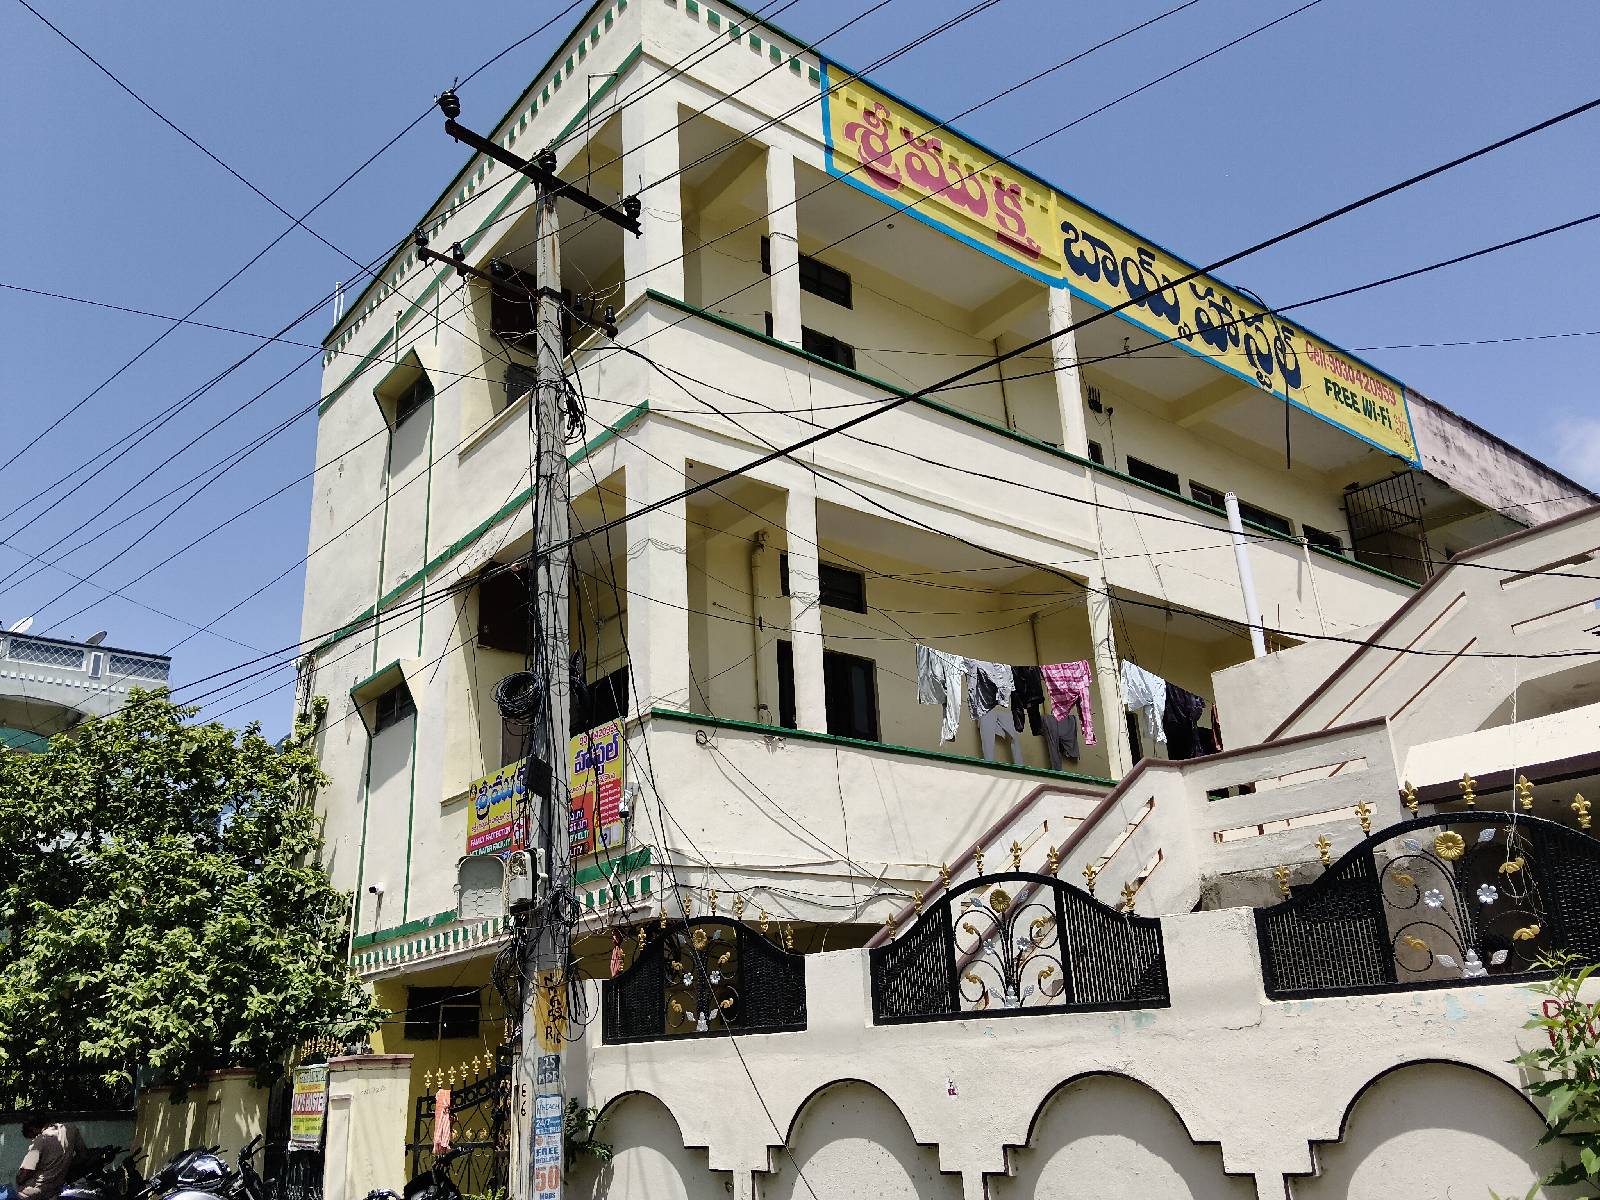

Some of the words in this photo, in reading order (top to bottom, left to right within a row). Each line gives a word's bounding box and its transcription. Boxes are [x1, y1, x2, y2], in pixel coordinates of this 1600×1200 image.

[1323, 376, 1362, 414] FREE
[535, 1146, 560, 1157] FREE
[535, 1164, 560, 1192] 50
